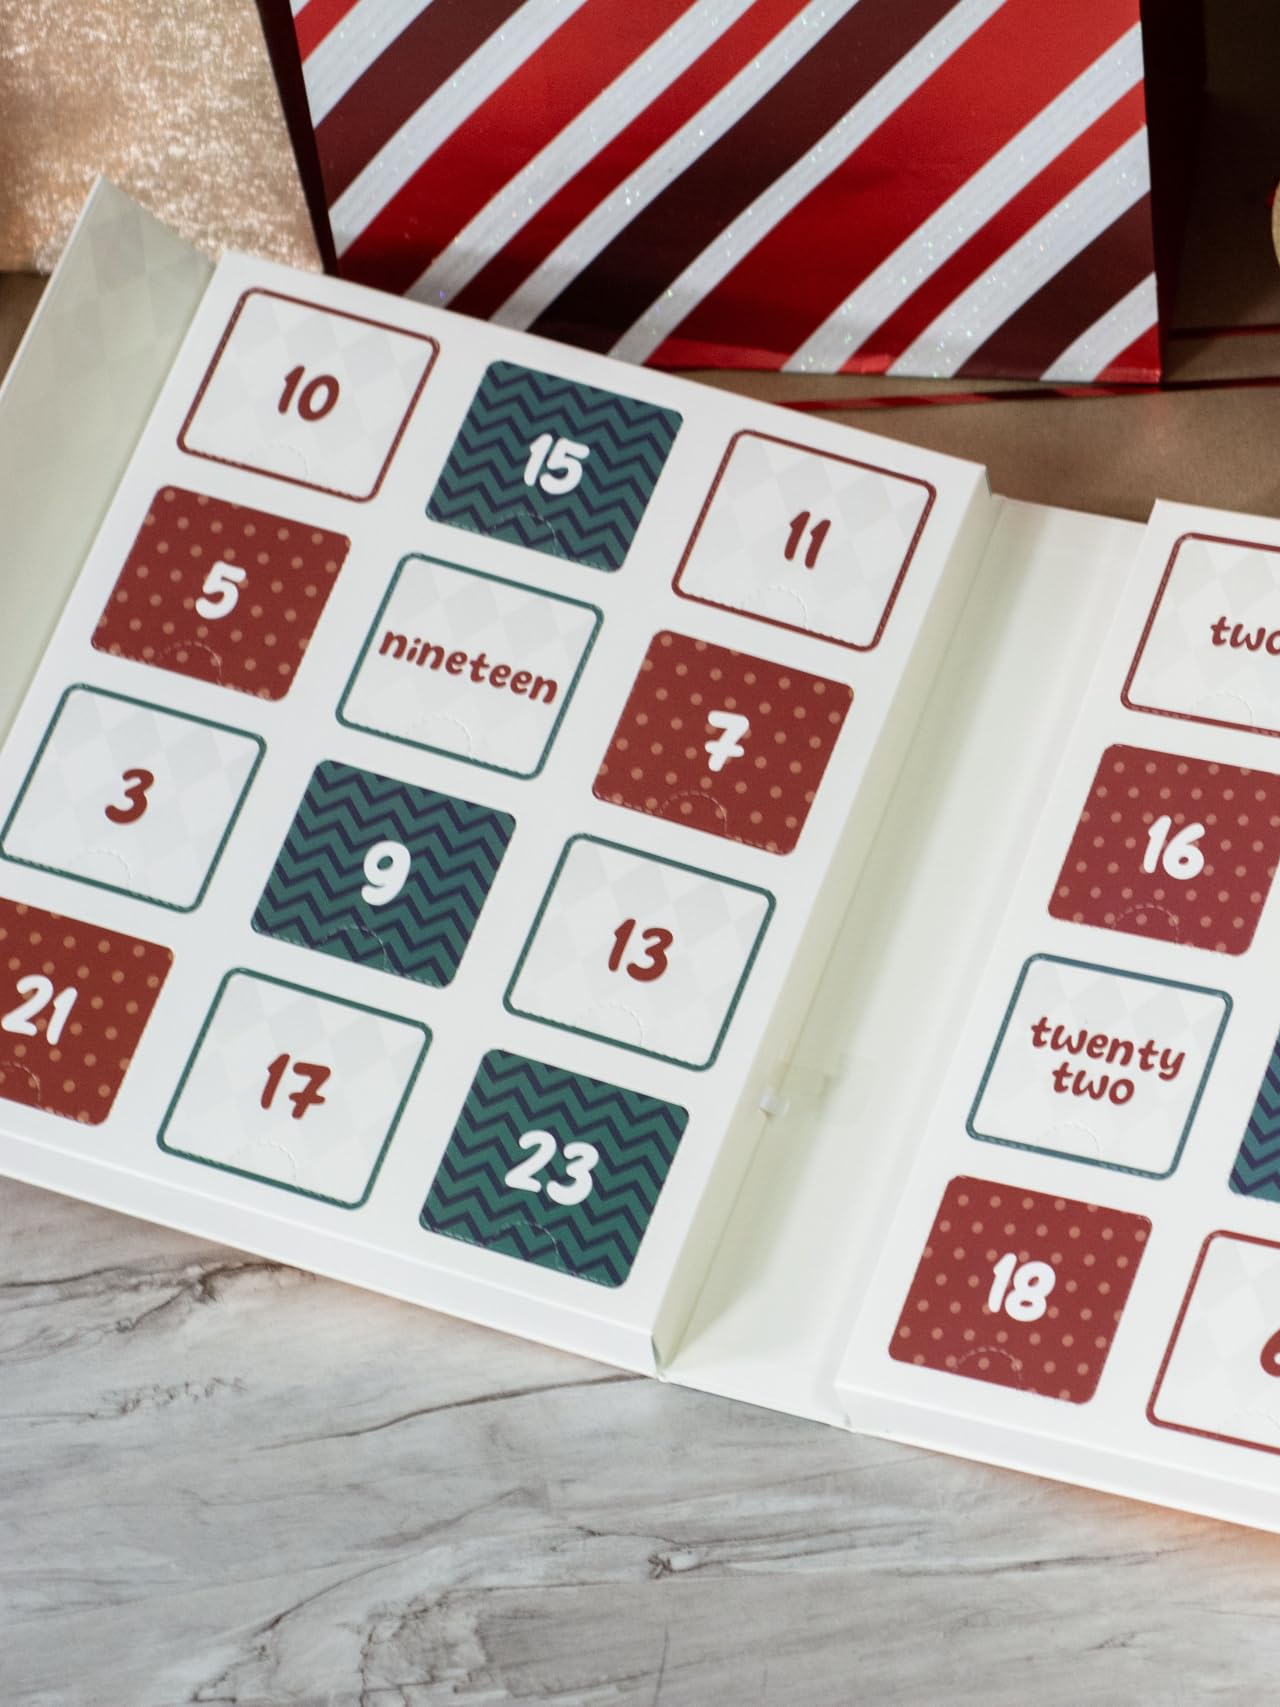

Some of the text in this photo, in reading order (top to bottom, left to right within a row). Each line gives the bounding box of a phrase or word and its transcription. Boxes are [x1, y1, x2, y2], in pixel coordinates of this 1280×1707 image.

[278, 366, 341, 422] 10
[524, 434, 590, 494] 15
[783, 510, 832, 569] 11
[195, 561, 246, 619] 5
[379, 631, 558, 705] nineteen
[704, 711, 750, 772] 7
[105, 768, 155, 825] 3
[361, 841, 411, 906] 9
[1143, 815, 1205, 880] 16
[607, 918, 674, 983] 13
[1, 975, 78, 1045] 21
[1031, 1017, 1186, 1081] twenty
[260, 1053, 332, 1120] 17
[1052, 1061, 1135, 1105] two
[504, 1130, 599, 1206] 23
[988, 1253, 1056, 1322] 18
